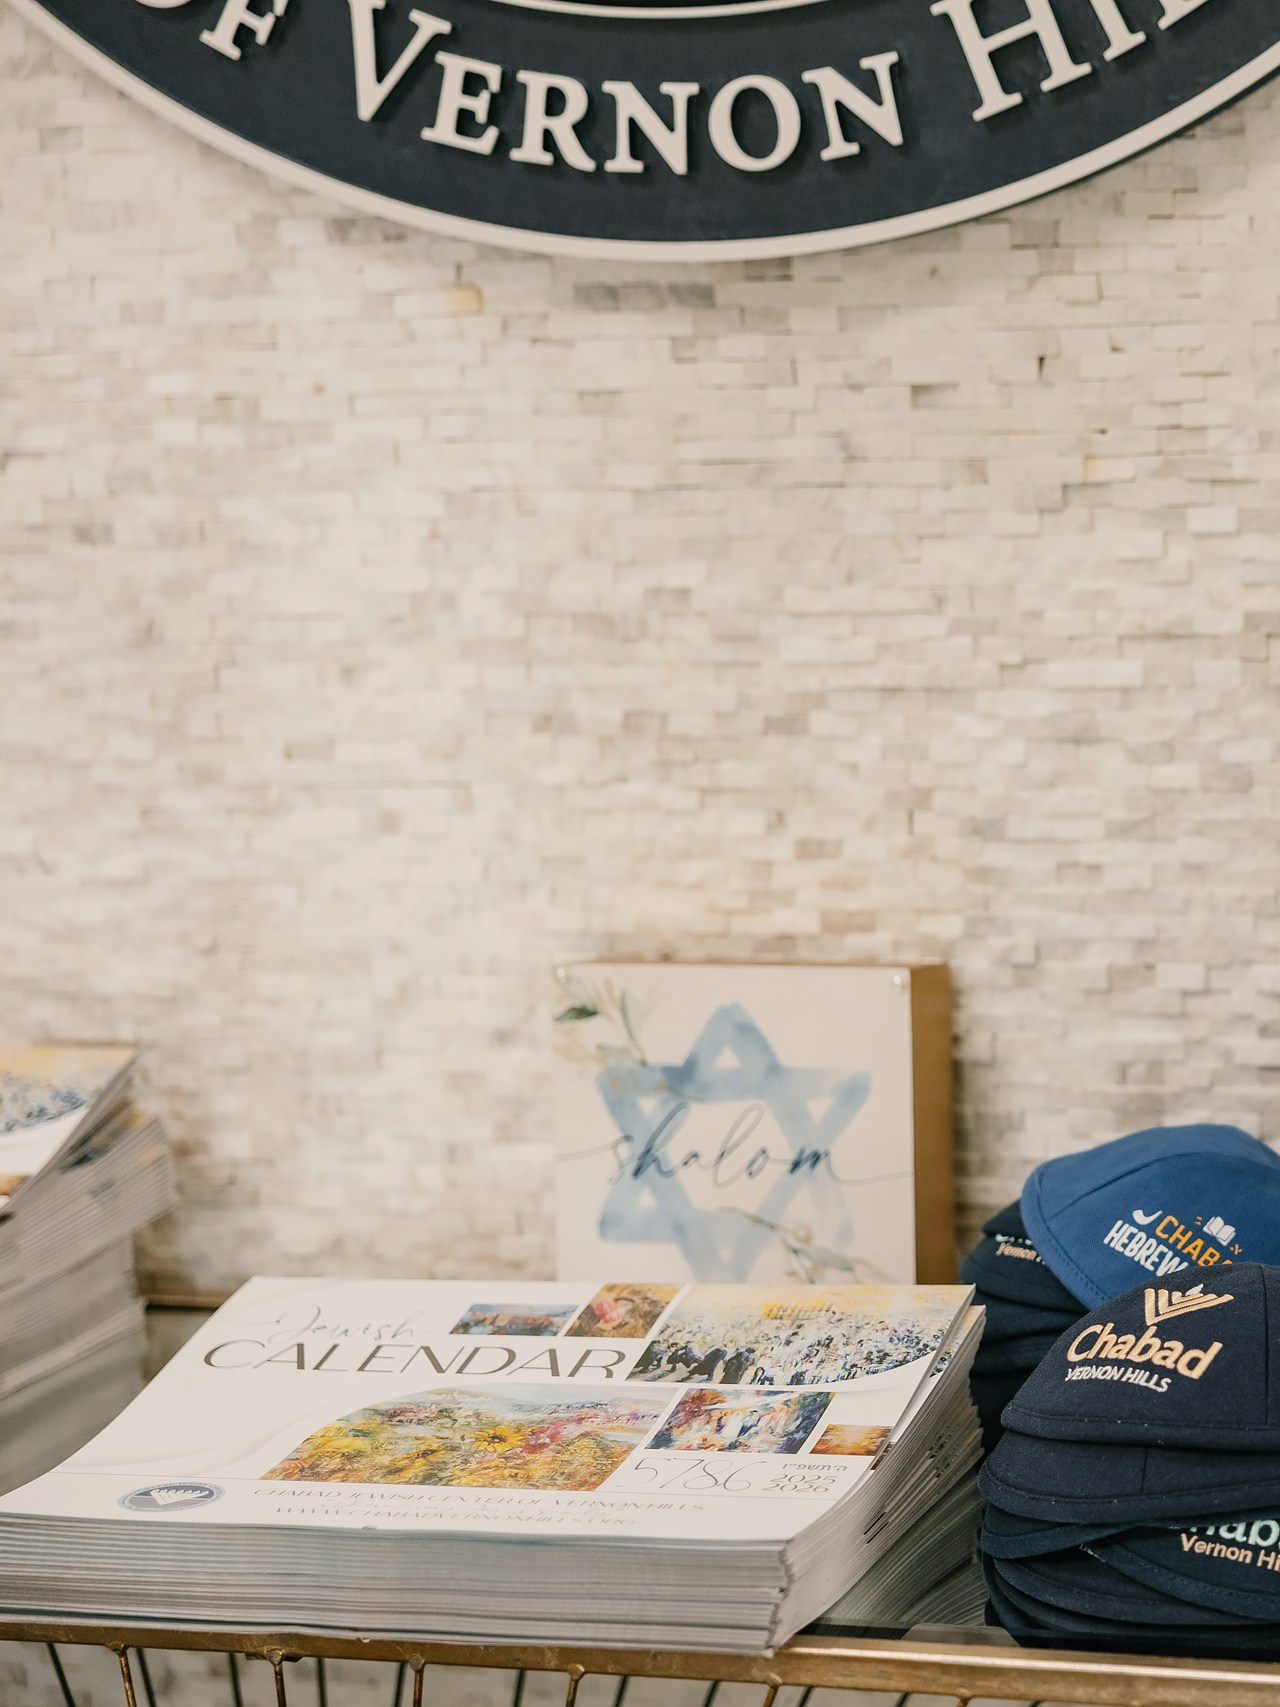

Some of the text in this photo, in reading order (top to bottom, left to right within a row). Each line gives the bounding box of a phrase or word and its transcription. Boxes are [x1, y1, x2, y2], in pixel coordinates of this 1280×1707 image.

[136, 0, 1204, 176] F VERNON HI
[557, 1101, 912, 1190] shalom
[1103, 1219, 1189, 1277] HEBREW
[1155, 1215, 1233, 1267] CHAB
[268, 1304, 426, 1344] Jewish
[203, 1339, 627, 1379] CALENDAR
[1066, 1322, 1224, 1380] Chabad
[1064, 1365, 1172, 1393] VERNON HILLS
[616, 1457, 767, 1491] 5786
[762, 1483, 829, 1493] 2026
[770, 1473, 838, 1484] 2025
[253, 1488, 341, 1498] CHABAD
[349, 1491, 425, 1501] JEWISH
[426, 1494, 514, 1505] CENTER
[517, 1497, 543, 1505] OF
[554, 1499, 646, 1509] VERNON
[647, 1502, 704, 1511] HILLS
[1180, 1532, 1253, 1564] Vernon
